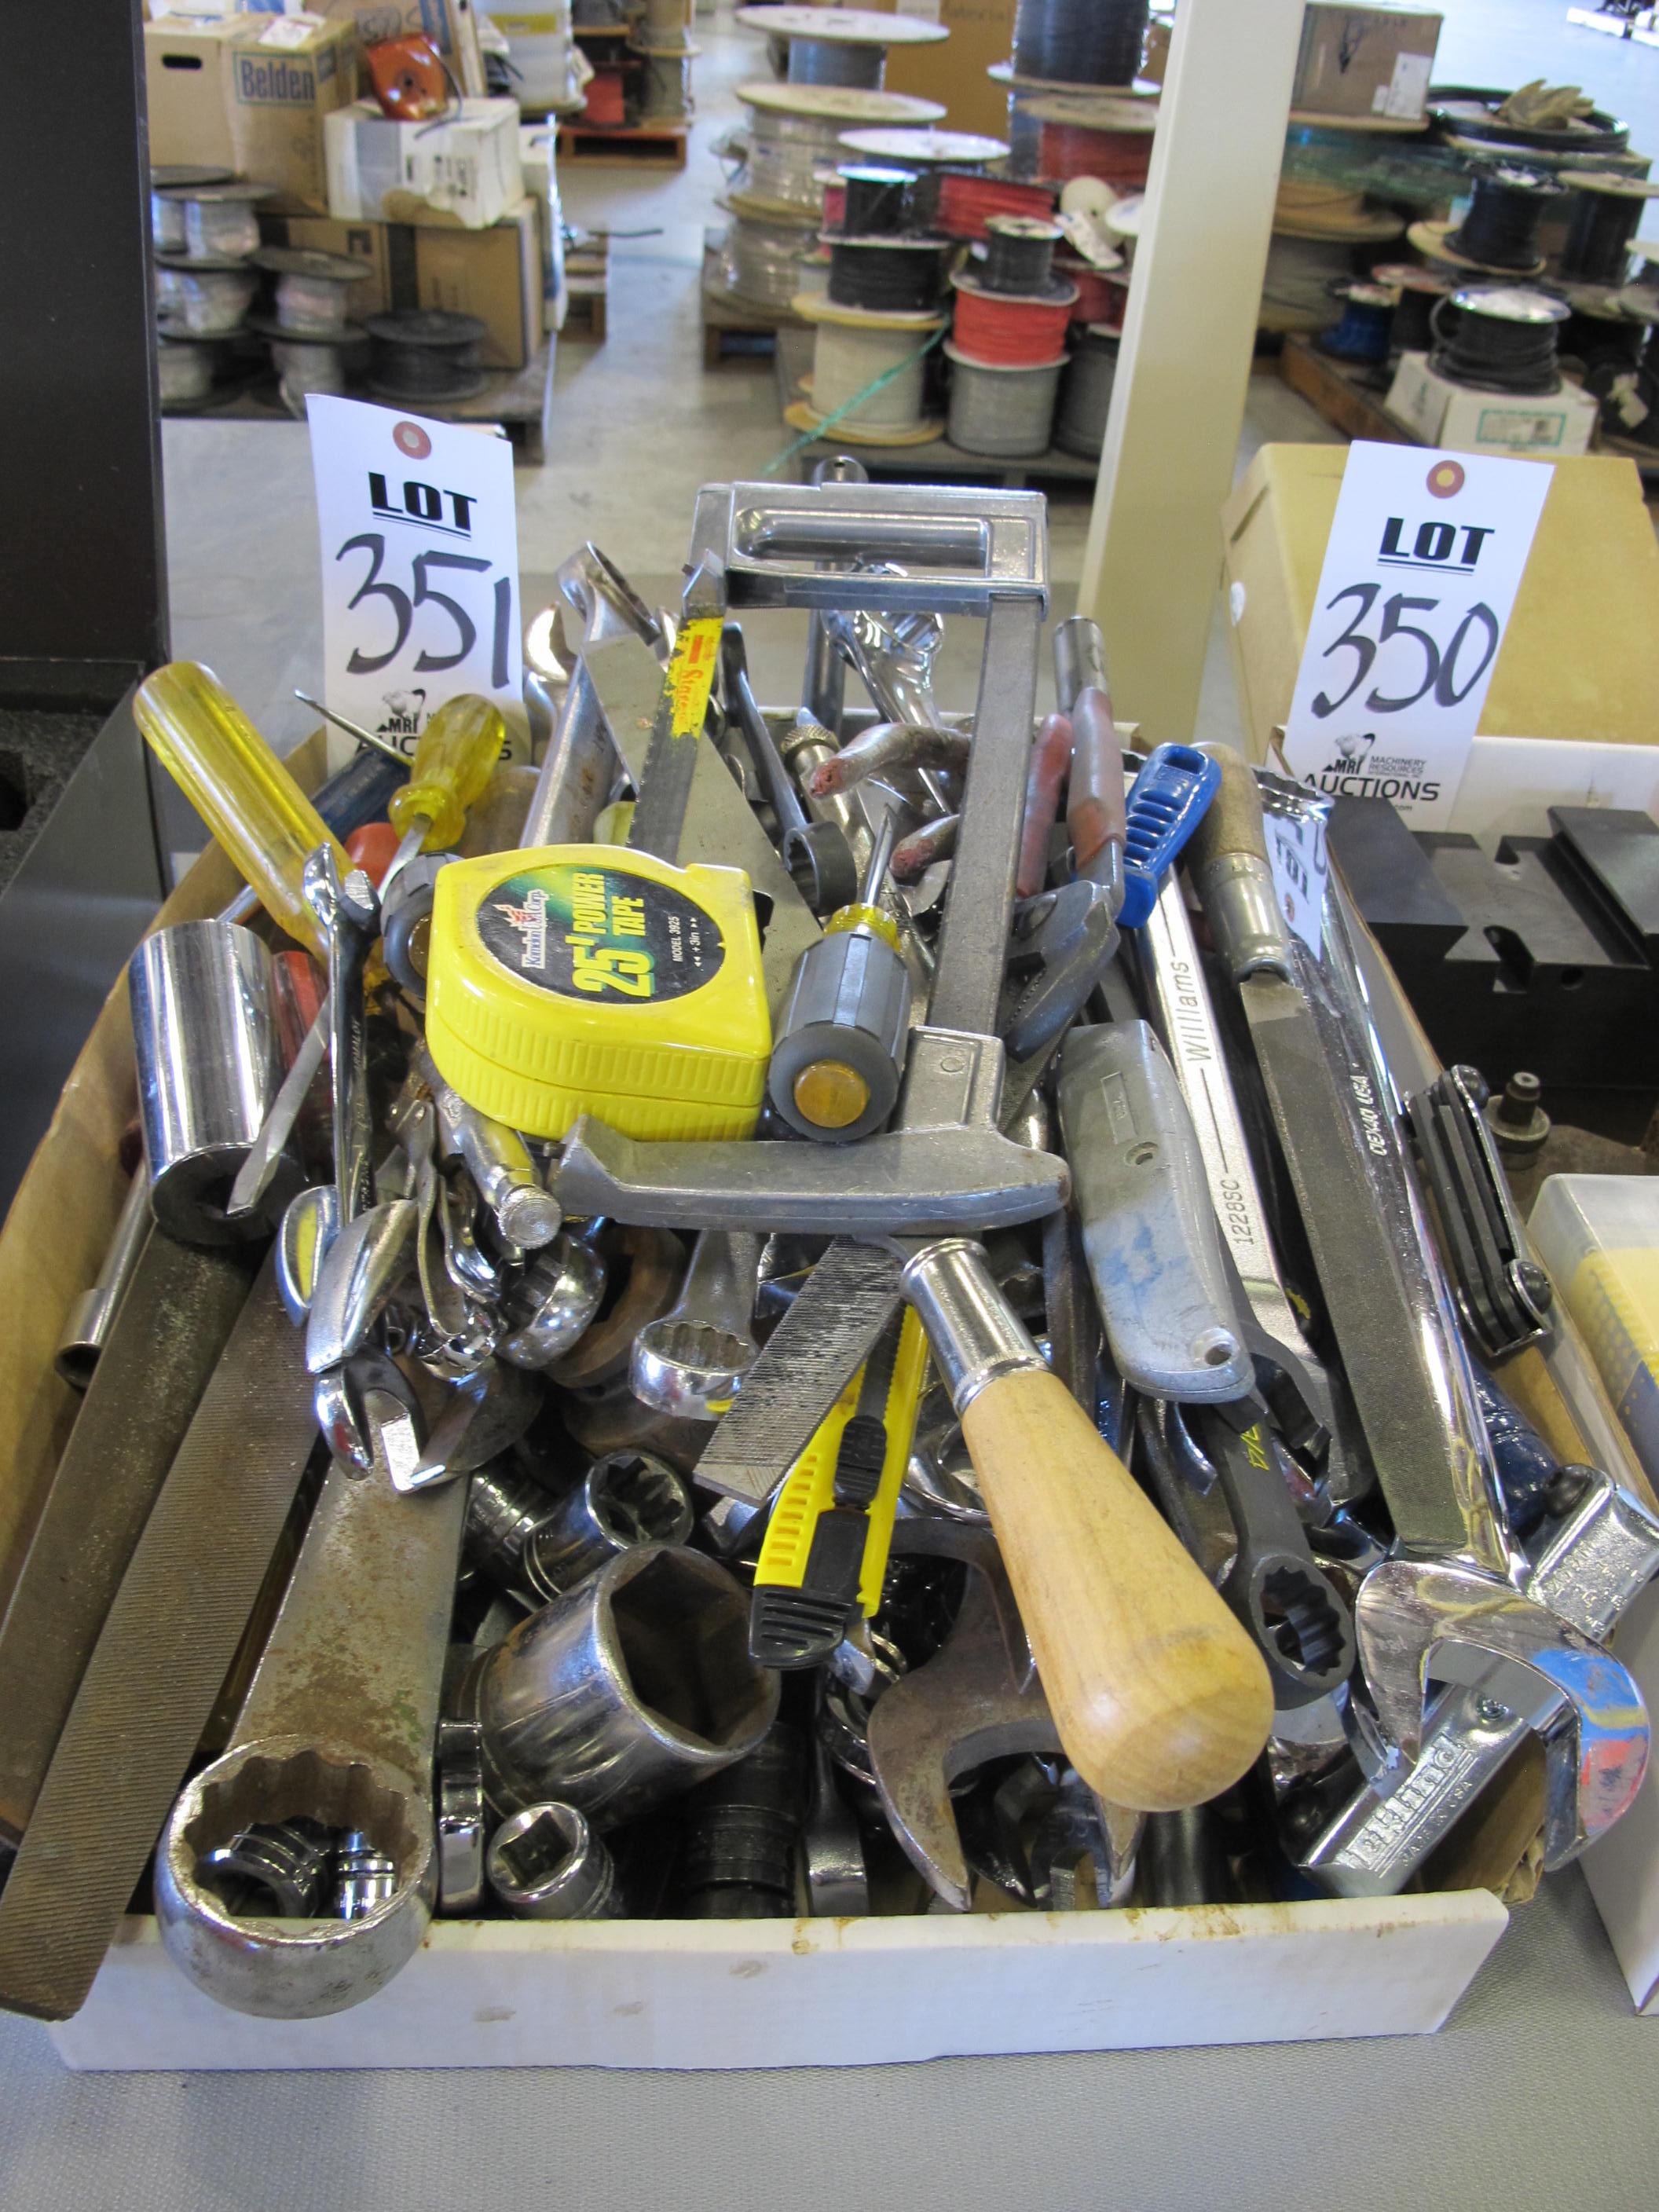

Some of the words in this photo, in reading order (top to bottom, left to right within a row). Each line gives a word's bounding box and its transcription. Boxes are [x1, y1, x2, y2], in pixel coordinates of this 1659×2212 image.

[240, 59, 315, 101] Belden
[367, 471, 478, 532] LOT
[1379, 516, 1496, 566] LOT
[335, 533, 511, 690] 351
[1310, 581, 1500, 720] 350
[387, 716, 418, 734] MRI
[1334, 758, 1363, 775] MRI
[1370, 755, 1428, 767] MACHINERY
[572, 873, 606, 935] POWER
[611, 895, 646, 936] TAPE
[668, 916, 681, 935] 3925
[671, 936, 683, 962] MODEL
[1173, 960, 1213, 1063] Williams
[1350, 1075, 1375, 1106] USA
[1222, 1178, 1254, 1246] 1228SC
